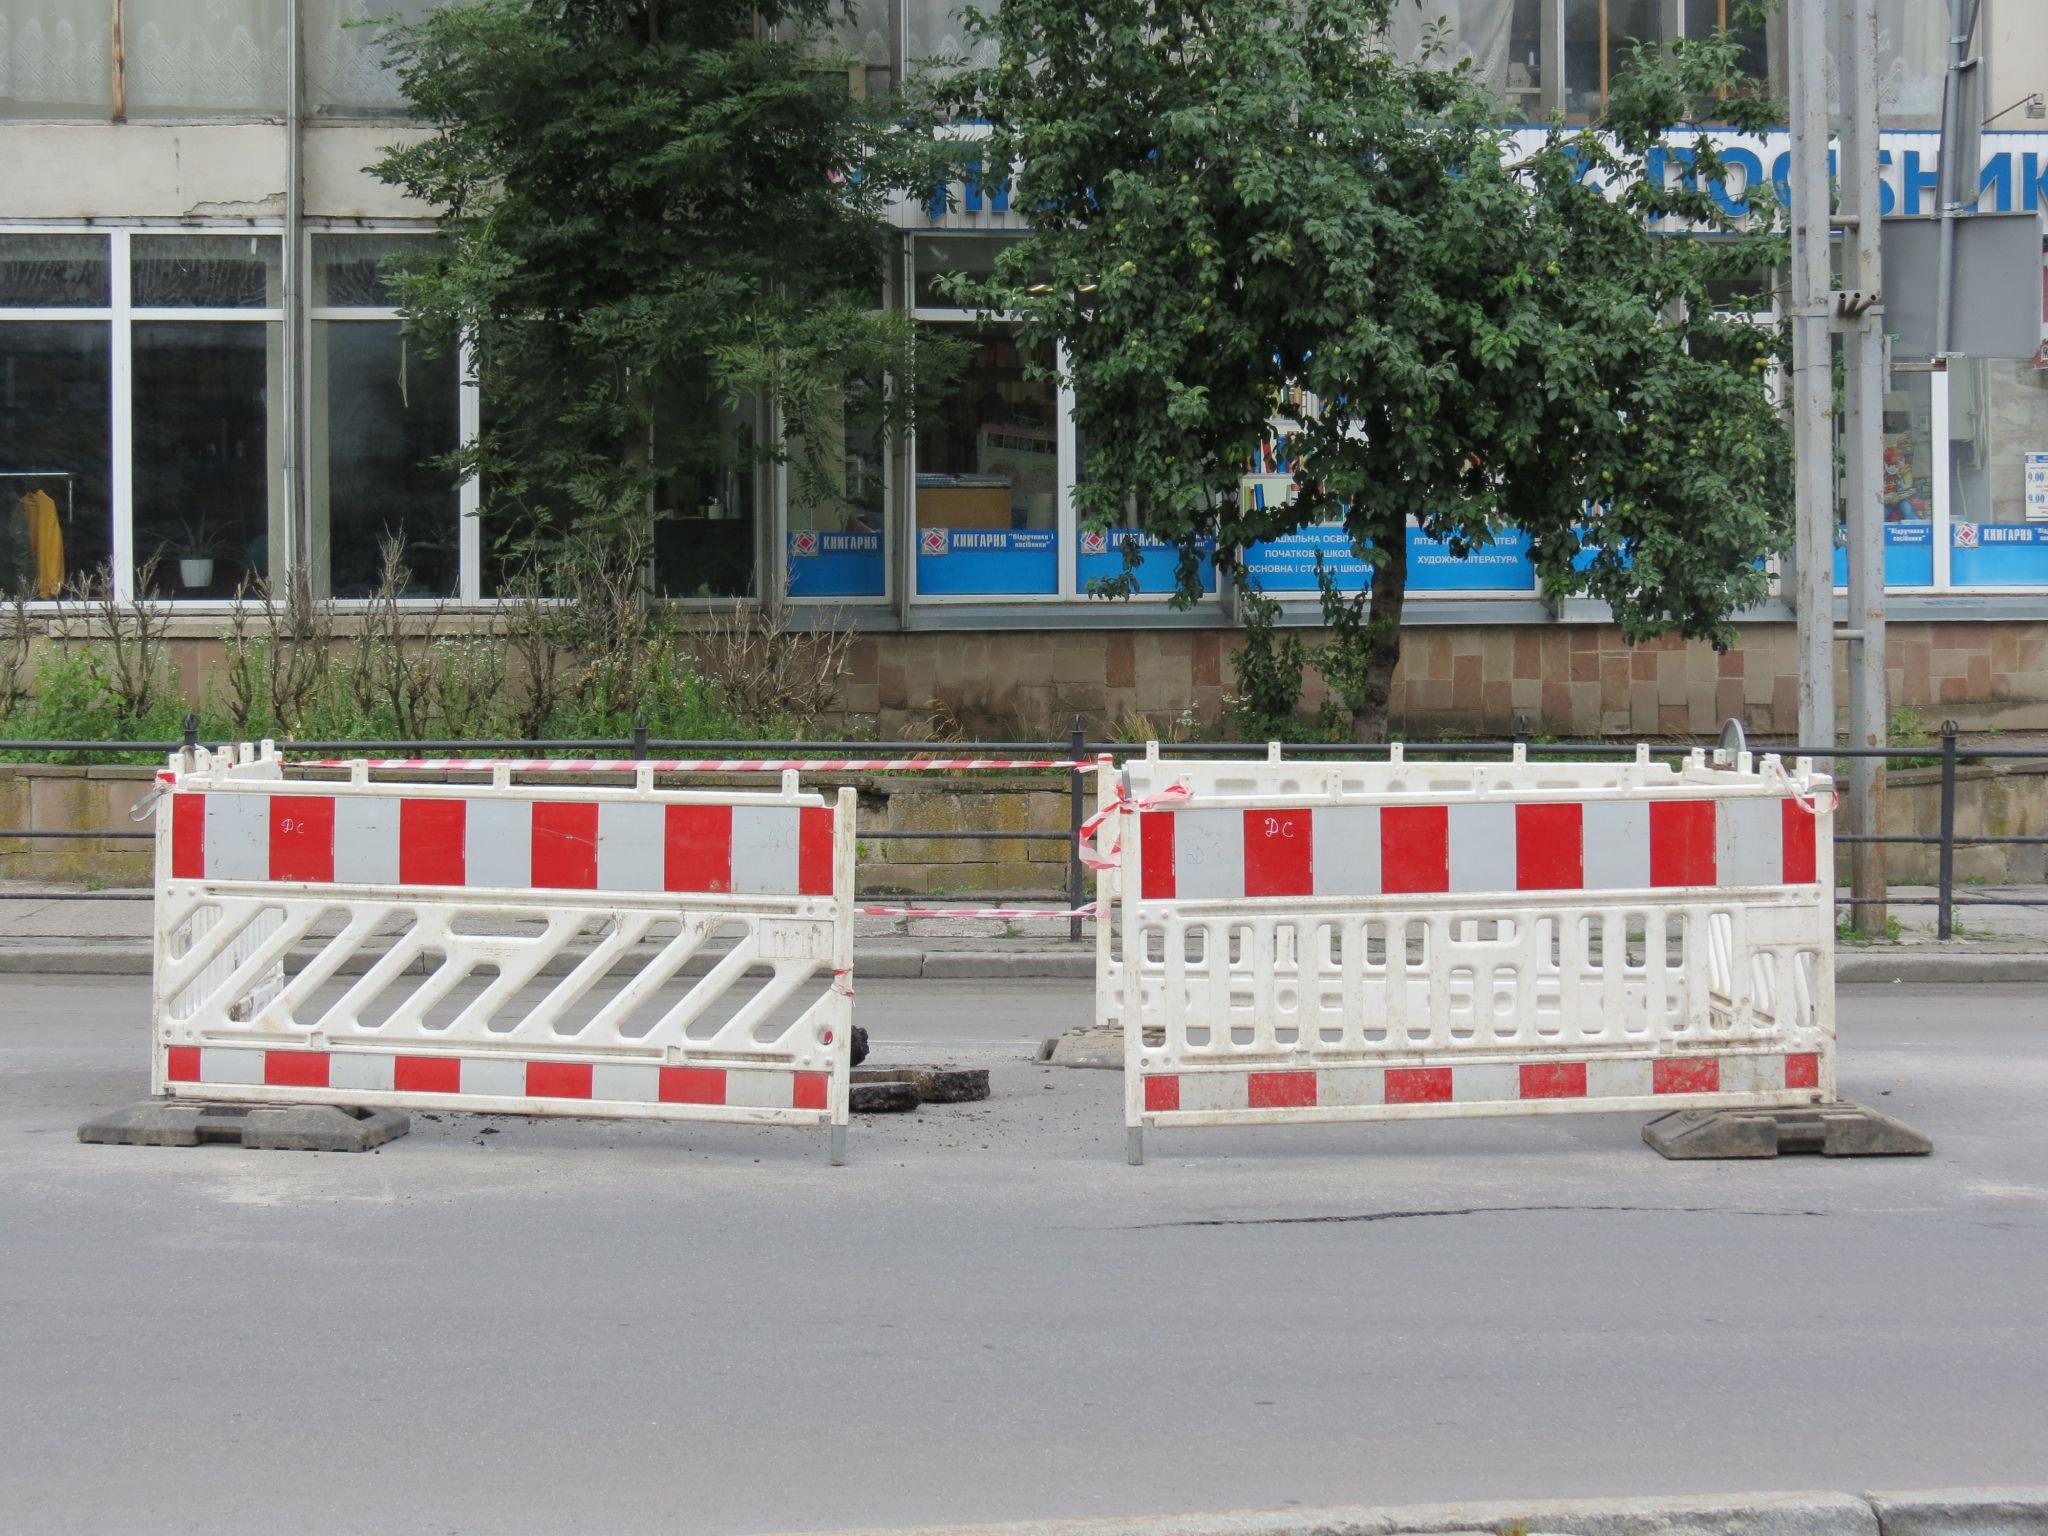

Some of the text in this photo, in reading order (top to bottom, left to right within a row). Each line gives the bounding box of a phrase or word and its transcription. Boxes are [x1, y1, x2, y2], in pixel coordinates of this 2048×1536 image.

[953, 533, 1007, 548] КНИГАРНЯ
[1984, 528, 2033, 541] КНИГАРНЯ
[823, 536, 878, 550] КНИГАРНЯ
[1265, 549, 1353, 558] ПОЧАТКОВ ШКОЛ
[1248, 564, 1293, 573] ОСНОВНА
[1340, 564, 1374, 573] ШКОЛА
